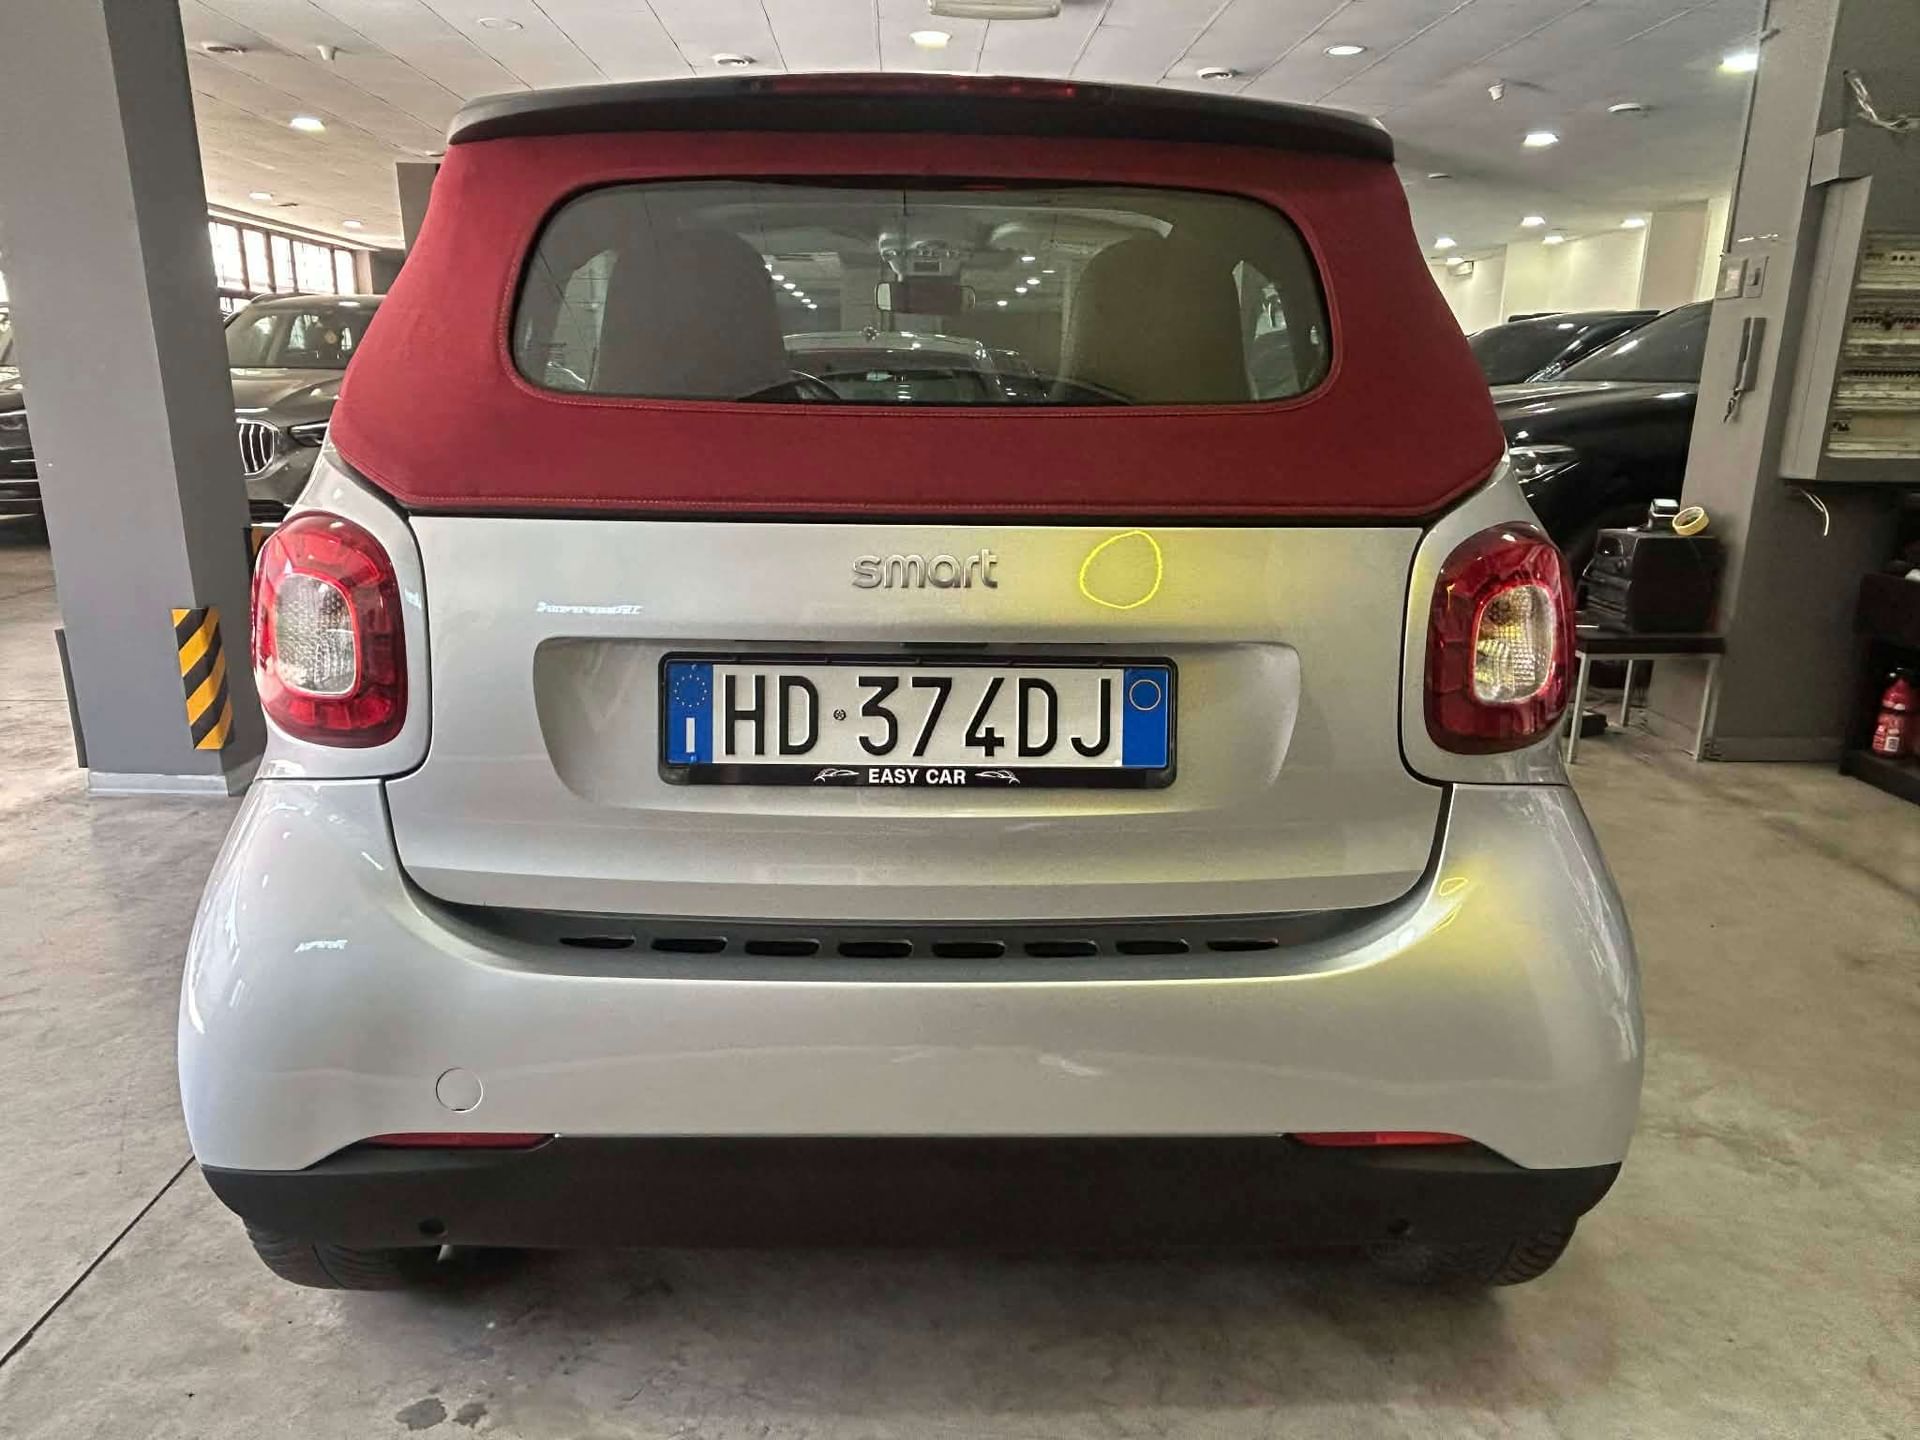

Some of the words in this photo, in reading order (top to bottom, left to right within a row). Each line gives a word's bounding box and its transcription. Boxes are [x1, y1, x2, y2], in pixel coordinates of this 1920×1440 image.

[852, 549, 998, 588] smart
[724, 674, 819, 756] HD
[858, 676, 1111, 757] 374DJ
[868, 769, 919, 784] EASY
[925, 769, 966, 784] CAR
